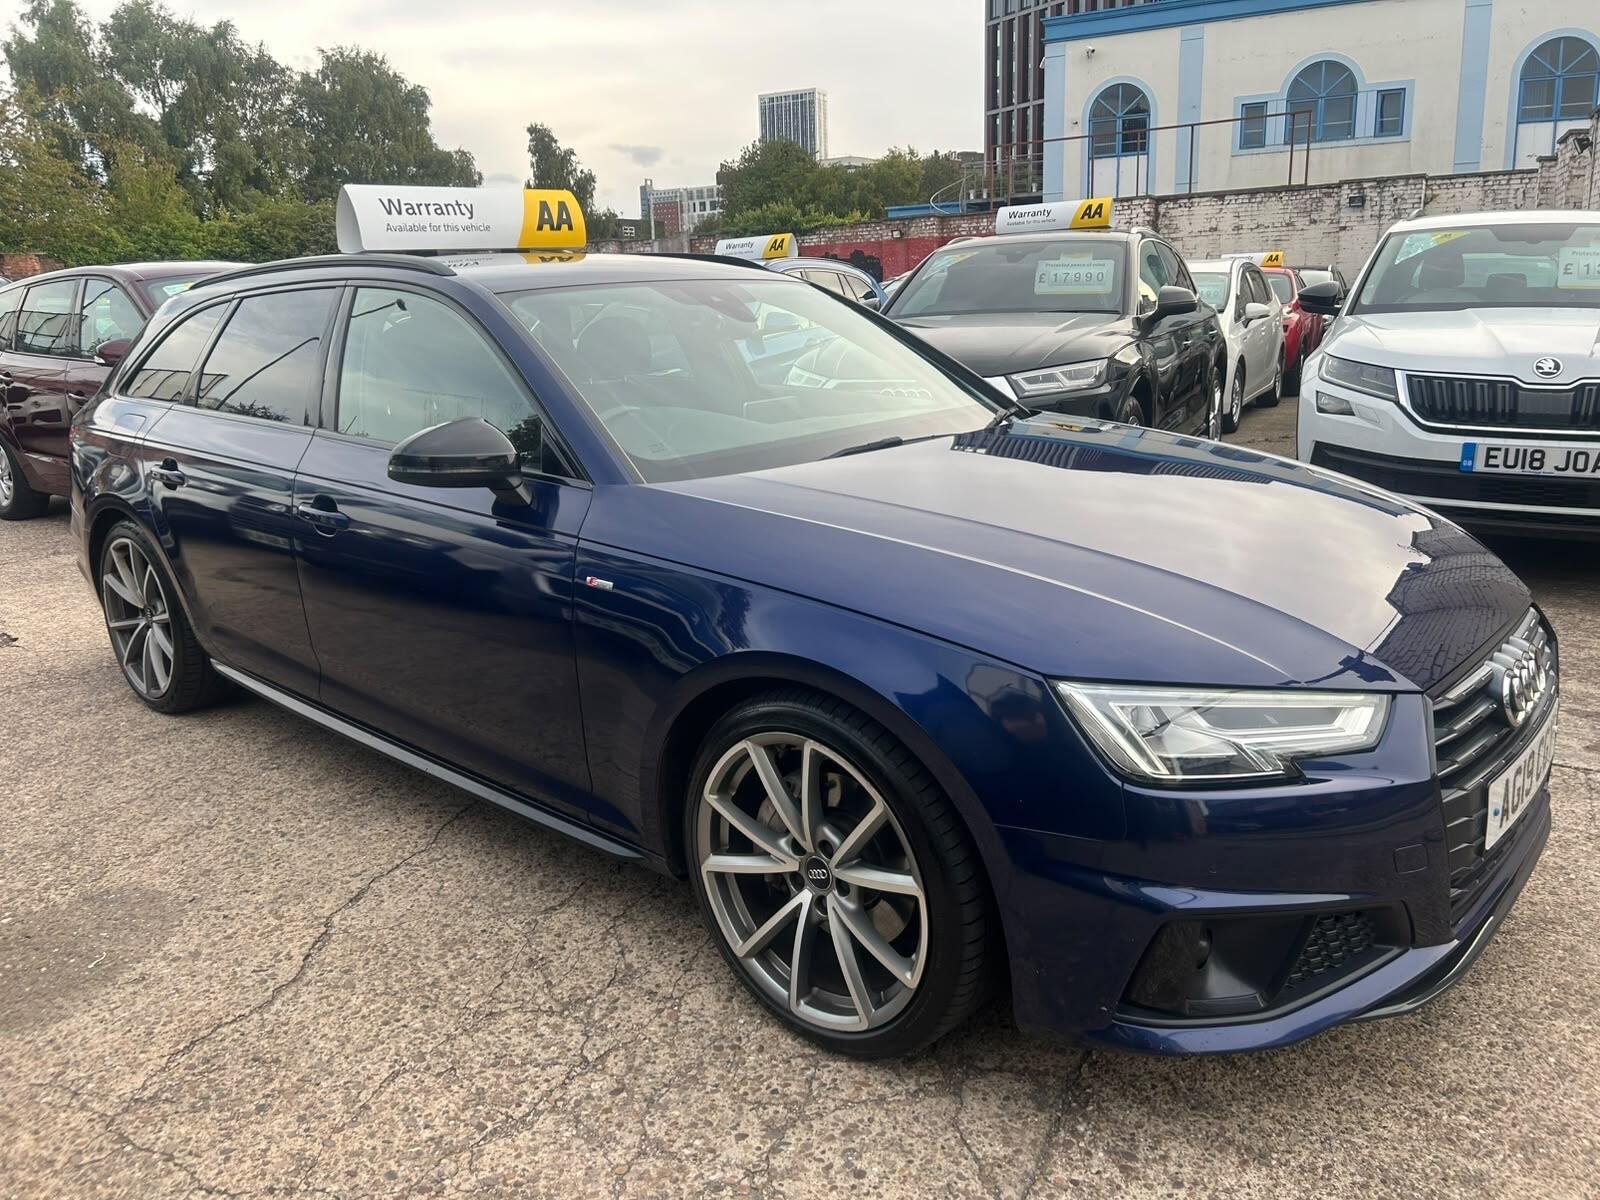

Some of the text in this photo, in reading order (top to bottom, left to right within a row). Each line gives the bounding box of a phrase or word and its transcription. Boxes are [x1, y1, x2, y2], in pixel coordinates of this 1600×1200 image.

[378, 197, 474, 220] Warranty
[536, 200, 574, 231] AA
[1008, 209, 1052, 219] Warranty
[1080, 203, 1104, 219] AA
[386, 223, 491, 232] Available for this vehicle
[725, 241, 754, 250] Warranty
[769, 238, 785, 252] AA
[1266, 254, 1279, 263] AA
[1484, 447, 1546, 470] EU18
[1499, 750, 1535, 828] AG19
